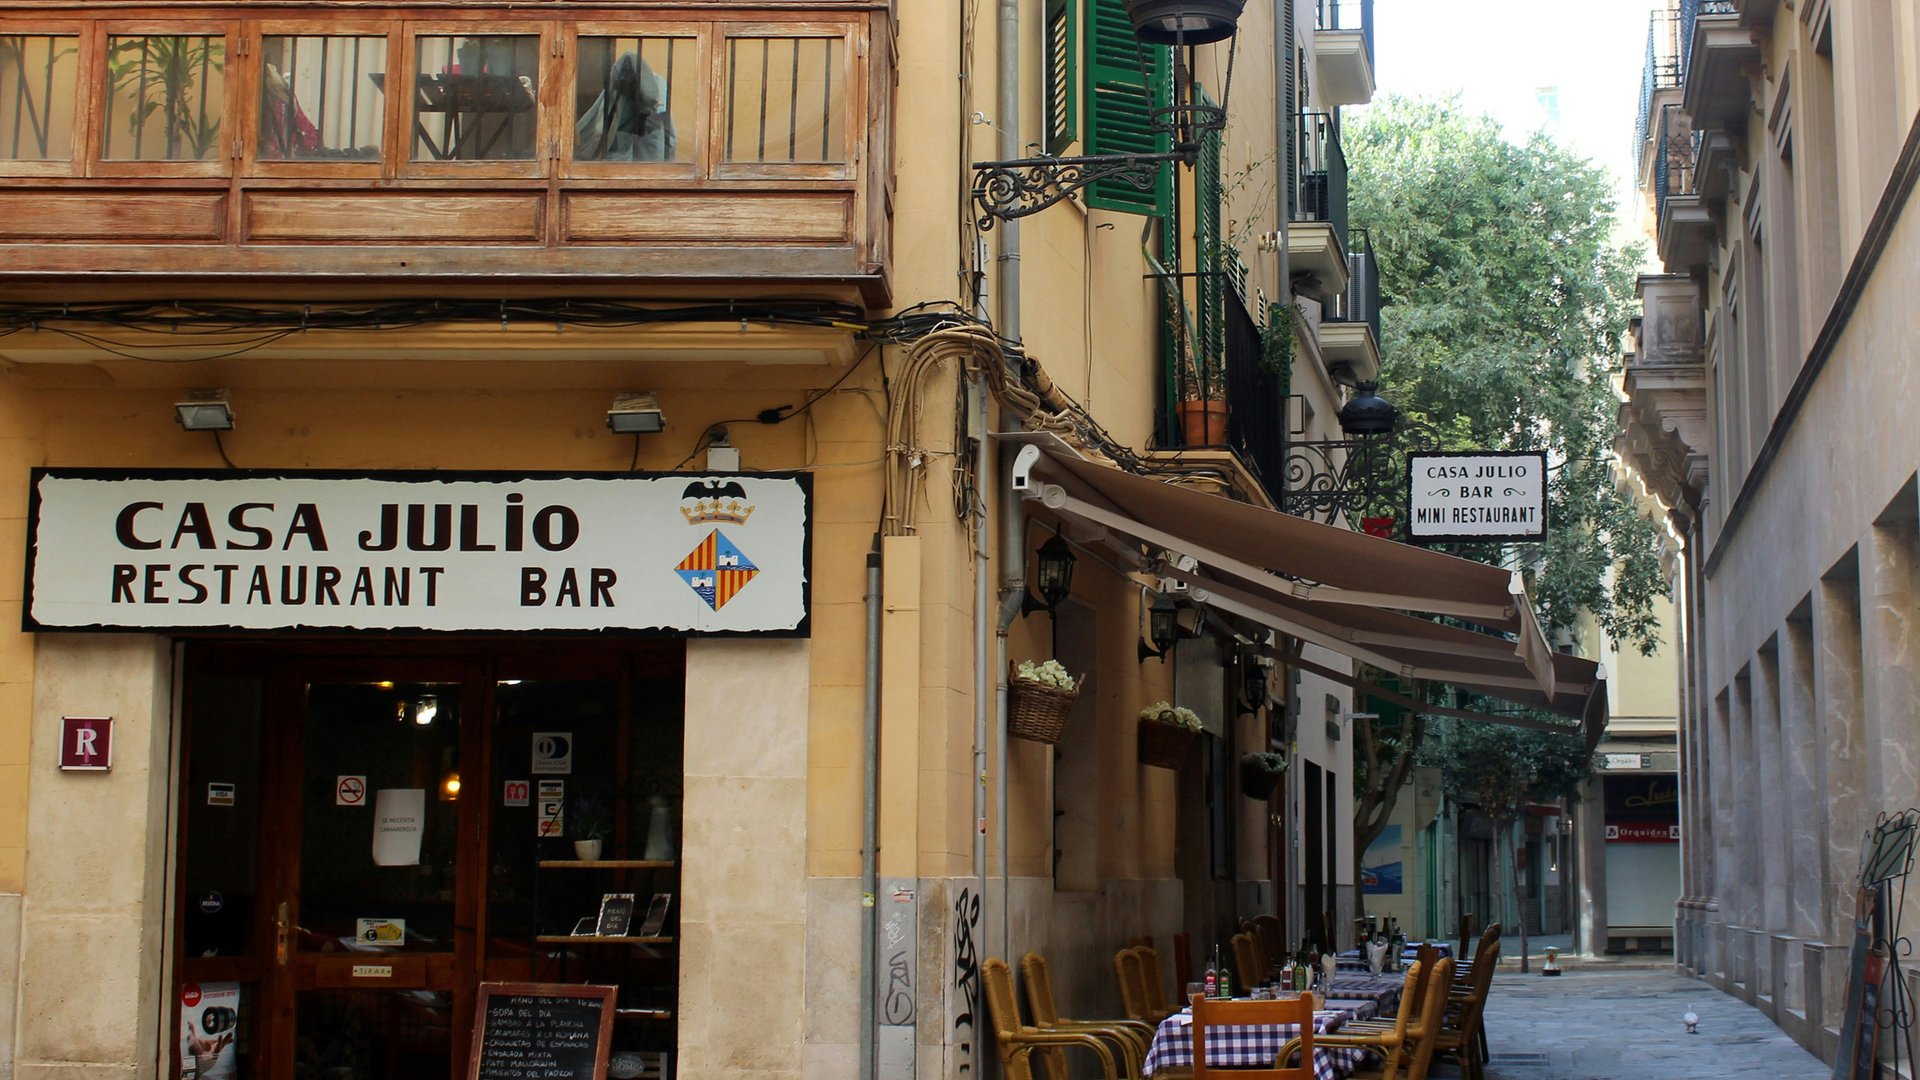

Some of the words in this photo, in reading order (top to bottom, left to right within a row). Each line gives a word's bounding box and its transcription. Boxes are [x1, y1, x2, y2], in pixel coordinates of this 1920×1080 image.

[1427, 466, 1469, 479] CASA
[1475, 465, 1527, 479] JULIO
[1460, 486, 1493, 498] BAR
[1417, 507, 1445, 523] MINI
[1452, 506, 1535, 523] RESTAURANT
[115, 501, 328, 552] CASA
[111, 564, 445, 607] RESTAURANT
[519, 566, 618, 608] BAR
[75, 728, 98, 755] R
